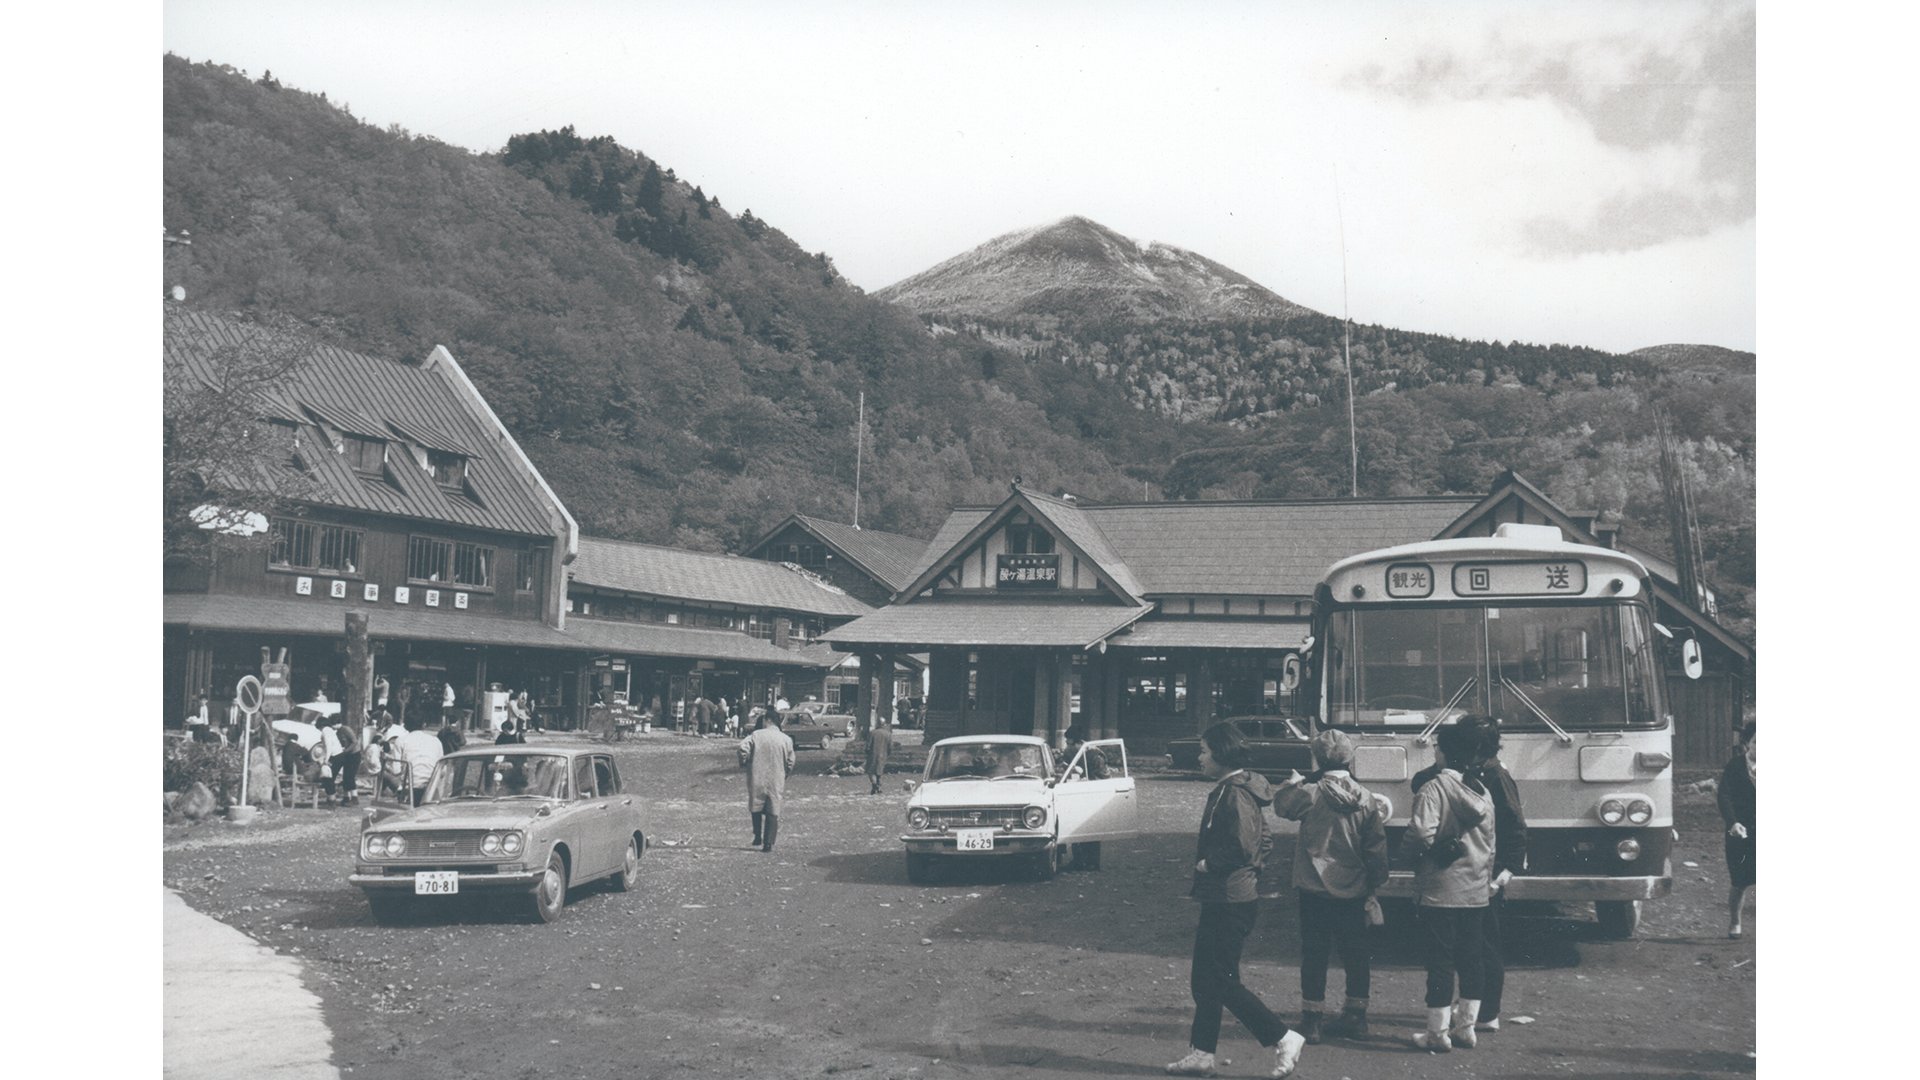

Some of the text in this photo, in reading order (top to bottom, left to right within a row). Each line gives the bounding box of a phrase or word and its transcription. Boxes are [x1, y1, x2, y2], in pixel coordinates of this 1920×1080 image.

[1392, 572, 1427, 589] 観光
[1470, 565, 1570, 591] 回送
[965, 838, 992, 849] 46-29
[425, 880, 455, 892] 70-81
